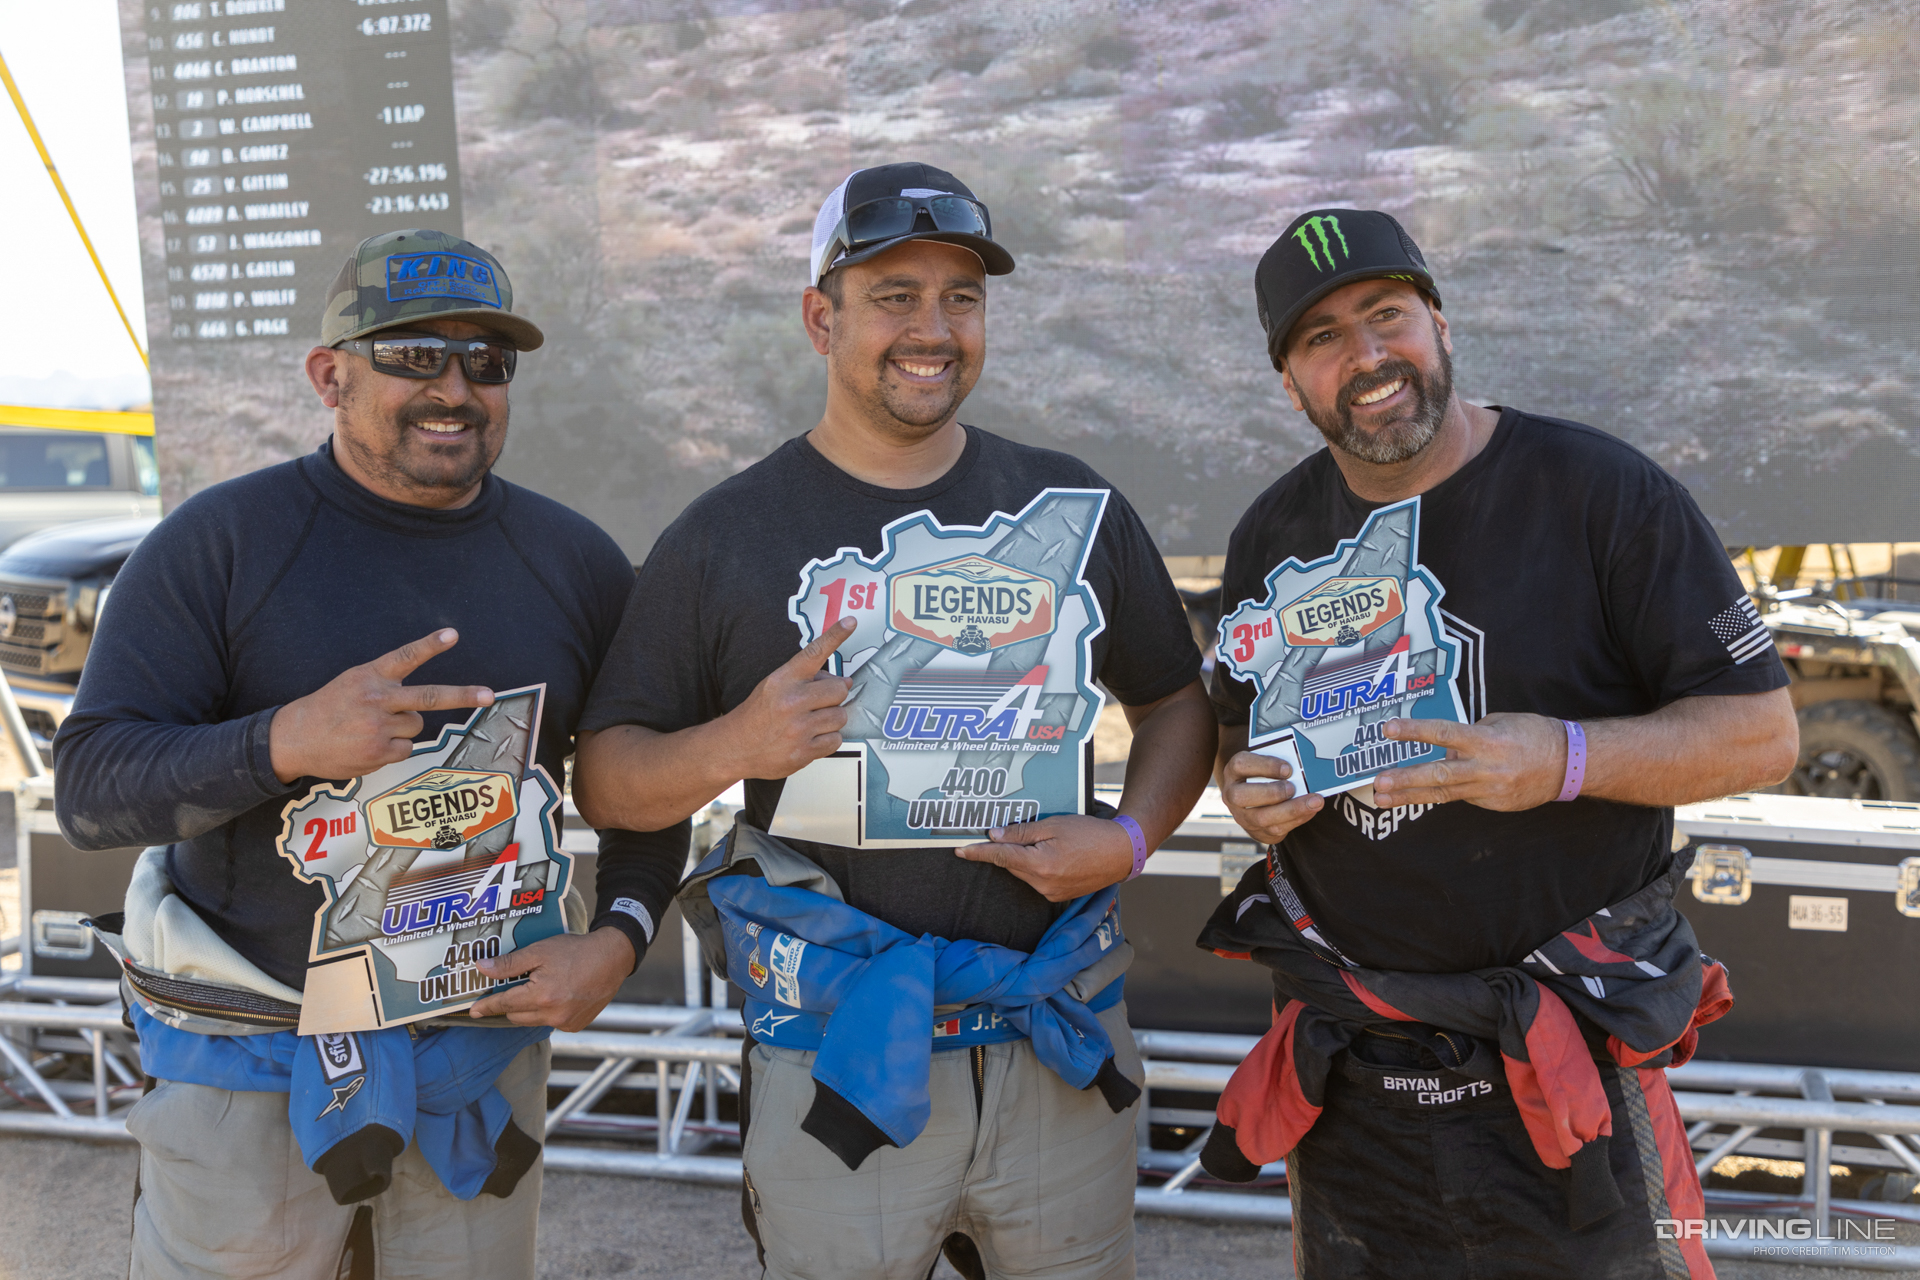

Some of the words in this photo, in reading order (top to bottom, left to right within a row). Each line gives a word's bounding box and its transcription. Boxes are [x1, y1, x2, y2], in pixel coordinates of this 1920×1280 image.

[219, 118, 240, 134] W.
[242, 112, 314, 133] CAMPBELL
[394, 103, 425, 124] LAP
[240, 144, 289, 162] GOMEZ
[227, 205, 243, 222] A.
[397, 256, 488, 285] KING
[404, 286, 447, 295] RACING
[450, 287, 487, 299] SHOCKS
[819, 578, 878, 636] 1st
[913, 583, 1032, 621] LEGENDS
[1296, 587, 1386, 635] LEGENDS
[950, 616, 964, 624] OF
[966, 616, 1010, 625] HAVASU
[1327, 621, 1339, 630] OF
[1339, 611, 1372, 626] HAVASU
[1232, 617, 1274, 663] 3rd
[1407, 673, 1436, 691] USA
[1302, 711, 1344, 730] Unlimited
[1345, 709, 1352, 719] 4
[1353, 702, 1380, 718] Wheel
[1381, 697, 1404, 710] Drive
[1405, 686, 1435, 704] Racing
[880, 741, 938, 751] Unlimited
[940, 741, 950, 750] 4
[952, 740, 988, 751] Wheel
[989, 741, 1020, 752] Drive
[1021, 742, 1060, 754] Racing
[1028, 726, 1066, 740] USA
[1353, 716, 1402, 749] 440
[940, 767, 1007, 797] 4400
[386, 784, 495, 834] LEGENDS
[424, 819, 437, 829] OF
[439, 811, 478, 826] HAVASU
[906, 799, 1041, 830] UNLIMITED
[303, 811, 357, 863] 2nd
[511, 888, 545, 907] USA
[383, 926, 434, 946] Unlimited
[436, 925, 445, 936] 4
[446, 916, 479, 933] Wheel
[480, 911, 507, 926] Drive
[508, 903, 543, 920] Racing
[1383, 1076, 1440, 1091] BRYAN
[1418, 1080, 1492, 1105] CROFTS
